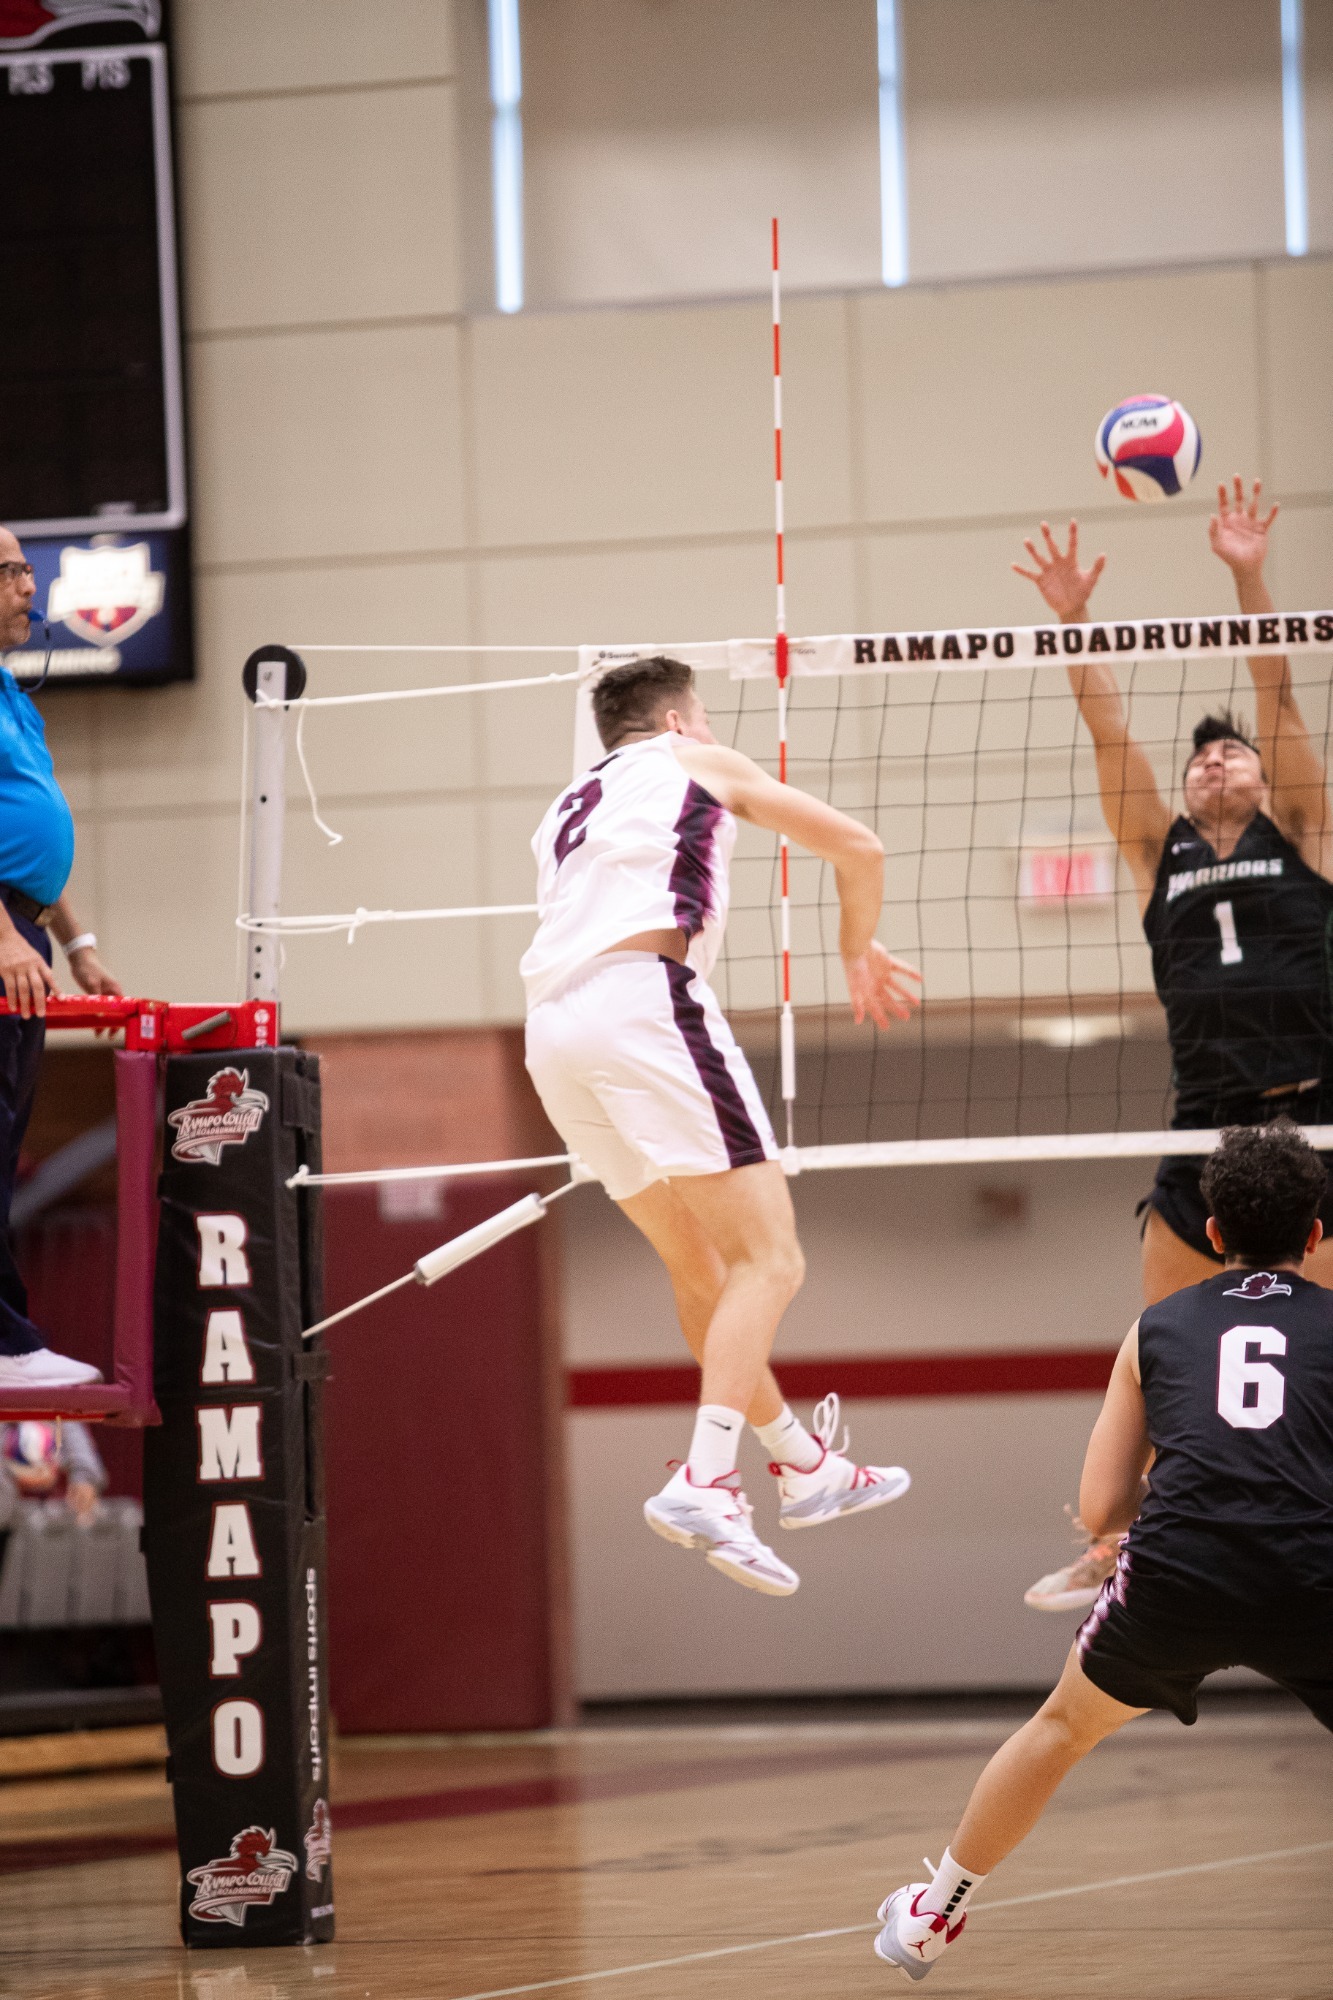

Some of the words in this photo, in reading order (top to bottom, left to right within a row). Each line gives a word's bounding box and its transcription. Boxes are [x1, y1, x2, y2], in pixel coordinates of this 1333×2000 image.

[853, 632, 1014, 664] RAMAPO
[1034, 615, 1333, 656] ROADRUNNERS
[554, 777, 603, 875] 2
[1214, 901, 1243, 965] 1
[1218, 1325, 1287, 1429] 6
[196, 1212, 266, 1778] RAMAPO
[305, 1567, 319, 1661] sports
[308, 1666, 321, 1782] imports
